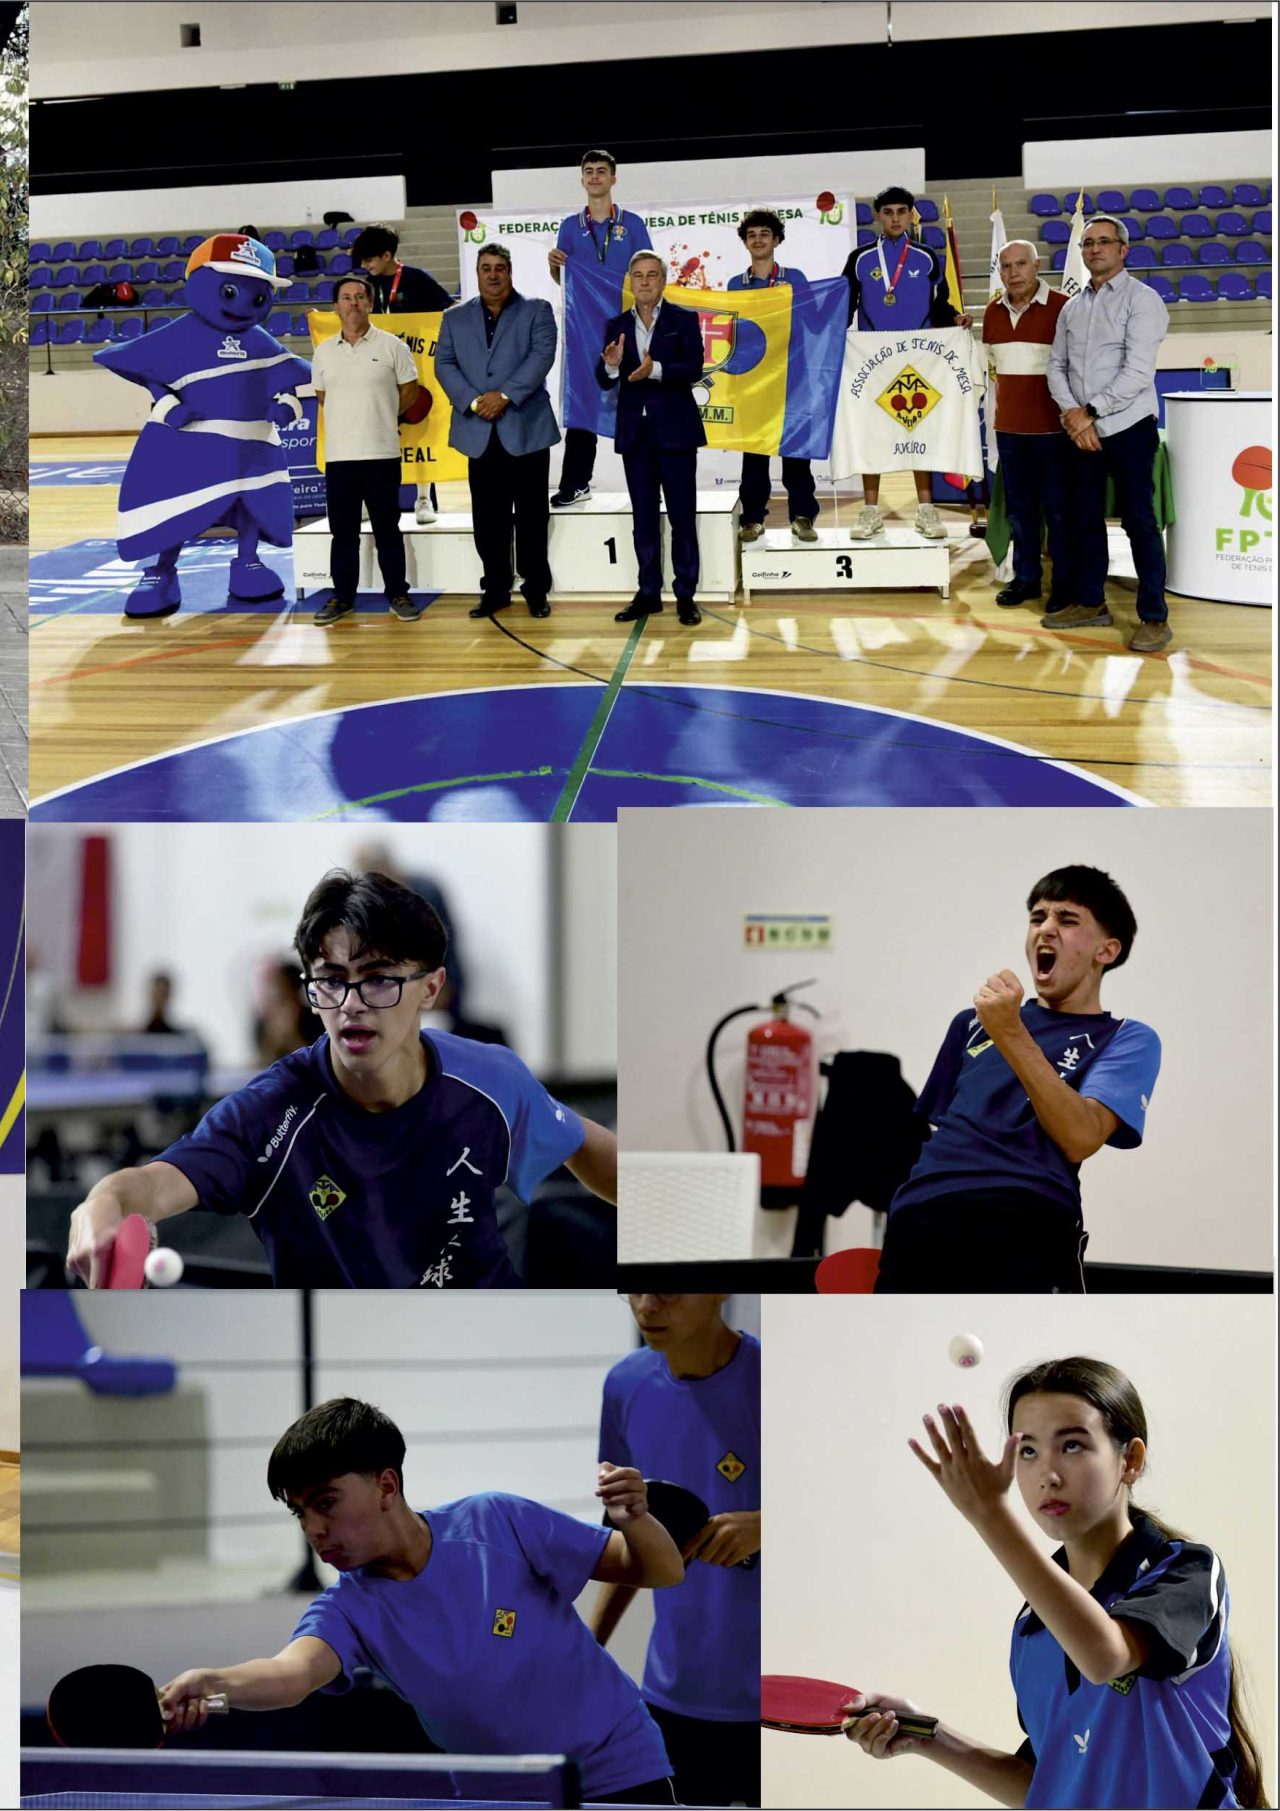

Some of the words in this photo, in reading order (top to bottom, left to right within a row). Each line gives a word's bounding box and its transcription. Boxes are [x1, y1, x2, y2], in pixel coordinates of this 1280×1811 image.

[499, 220, 562, 235] FEDERAÇ
[678, 215, 696, 227] DE
[699, 211, 740, 225] TÉNIS
[777, 208, 803, 220] ESA
[851, 346, 893, 399] ASSOCIAÇÃO
[896, 340, 908, 353] DE
[912, 338, 945, 355] TÉNIS
[943, 350, 959, 365] DE
[952, 366, 972, 395] MESA
[400, 446, 437, 463] EAL
[893, 440, 926, 454] AVEIRO
[604, 537, 617, 564] 1
[836, 555, 853, 579] 3
